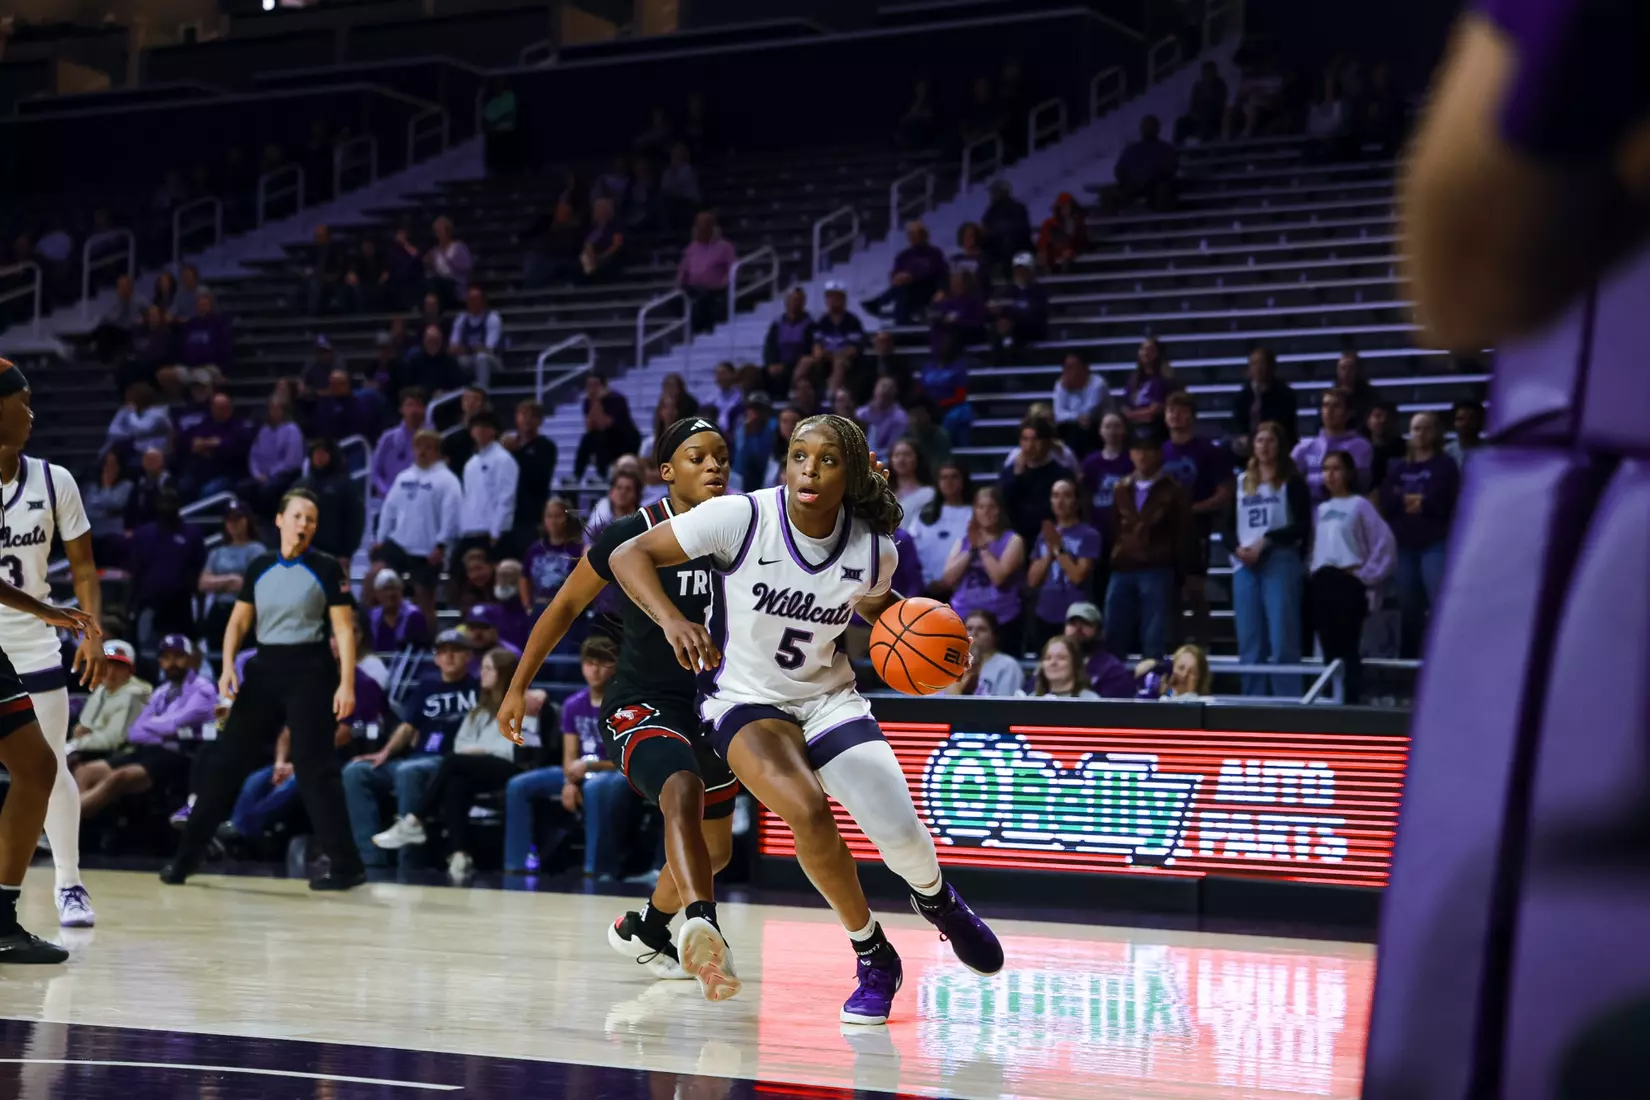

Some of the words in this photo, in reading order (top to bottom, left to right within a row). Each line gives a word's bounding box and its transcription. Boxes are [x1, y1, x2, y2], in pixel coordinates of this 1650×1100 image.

[1248, 507, 1268, 529] 21
[752, 582, 853, 626] Wildcats
[774, 626, 815, 671] 5
